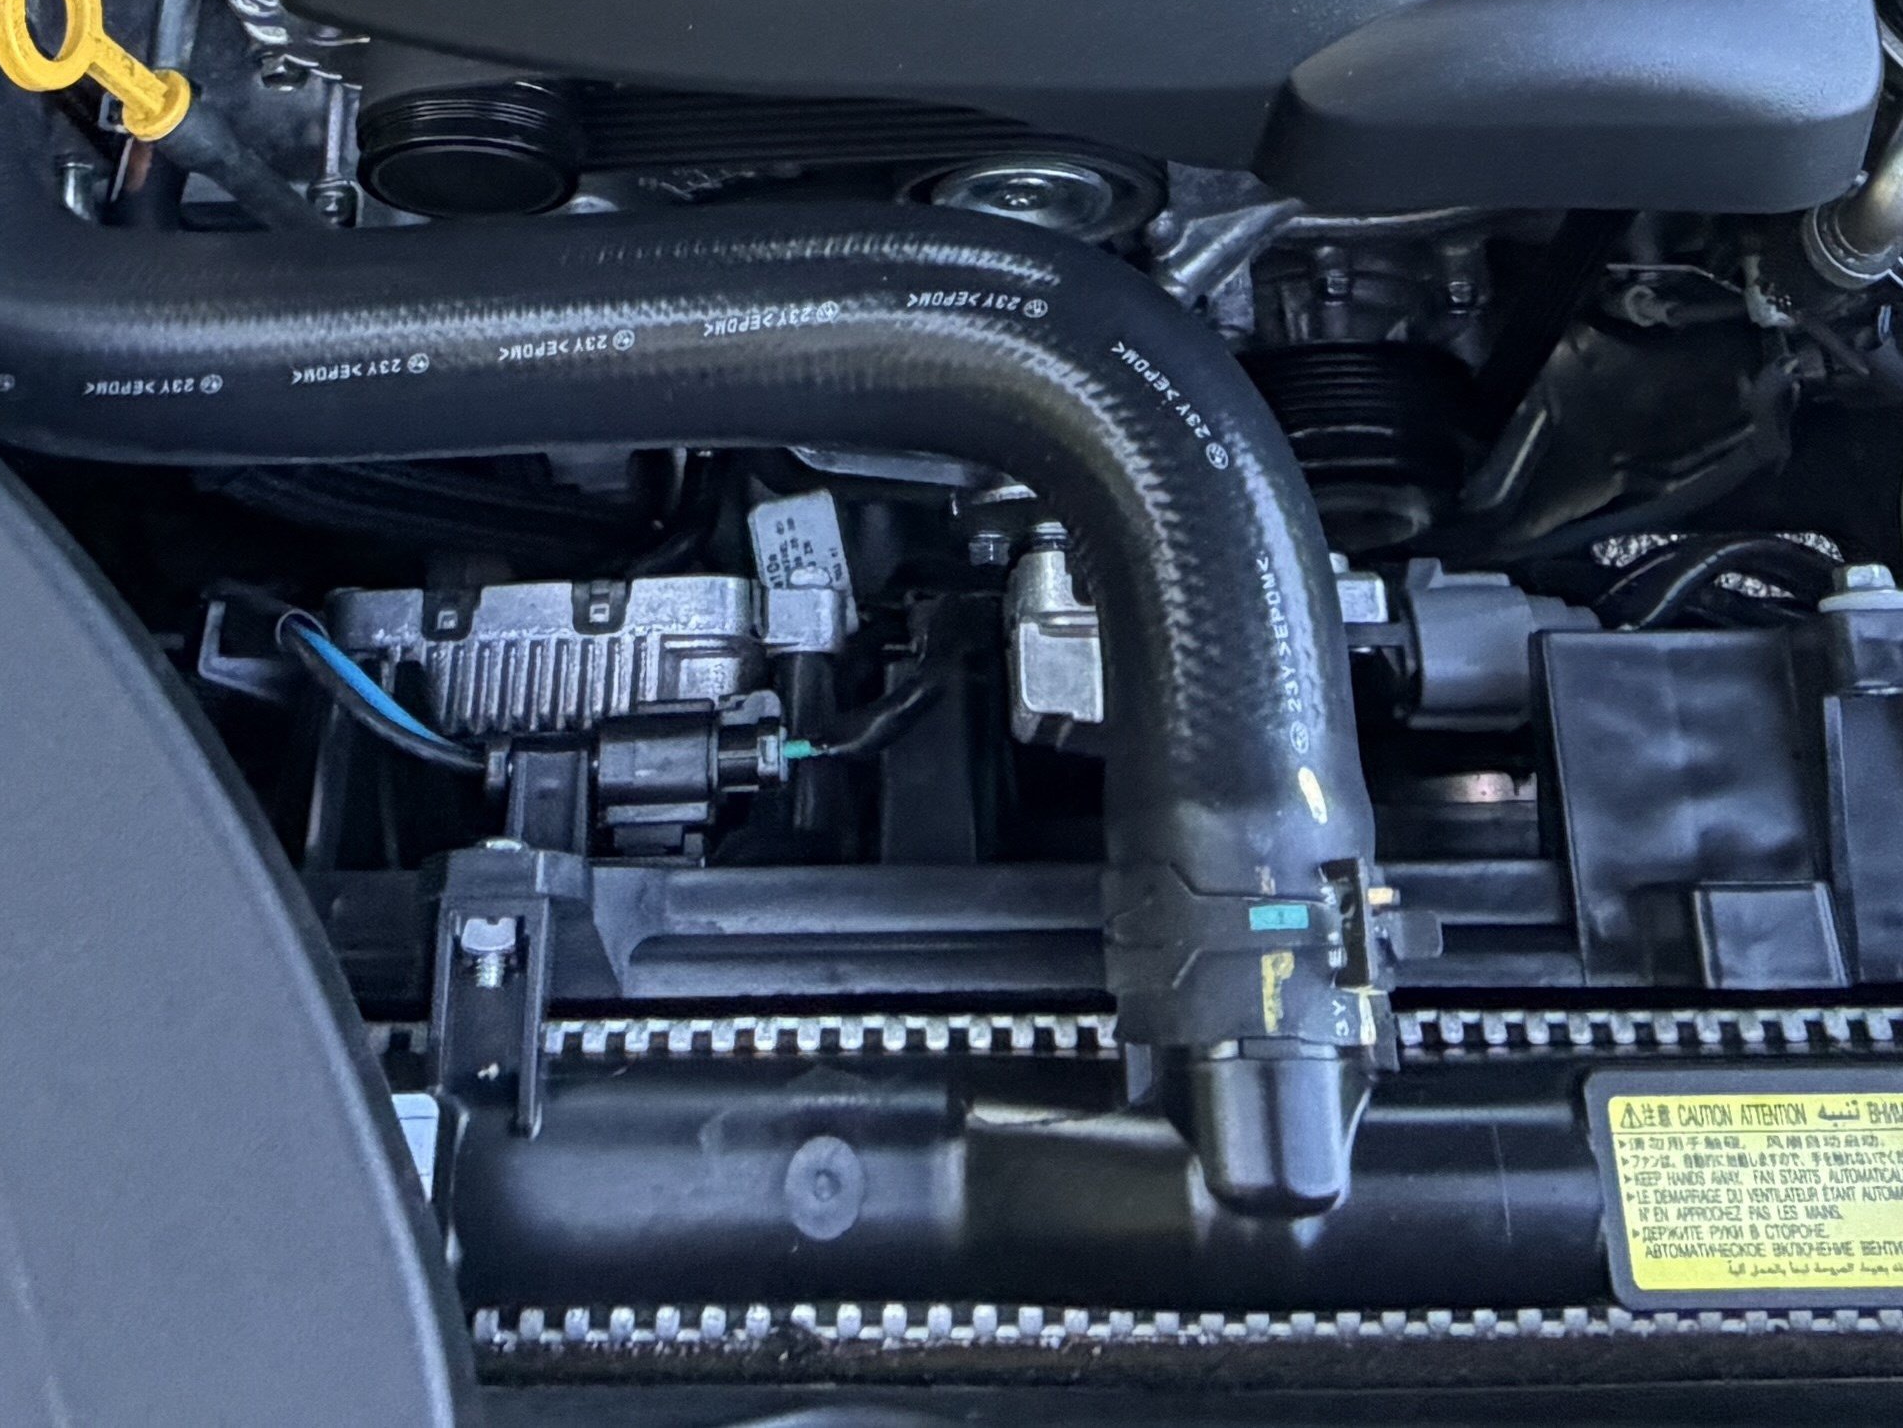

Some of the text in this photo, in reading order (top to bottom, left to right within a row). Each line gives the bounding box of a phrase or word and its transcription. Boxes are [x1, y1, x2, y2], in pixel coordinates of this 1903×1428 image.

[905, 289, 1022, 312] 23Y >EPDM<
[701, 306, 813, 337] 23Y >EPDM<
[496, 333, 609, 363] 23Y >EPDM<
[289, 356, 403, 384] 23Y >EPDM<
[83, 377, 195, 395] 23Y >EPDM<
[1111, 340, 1211, 447] 23Y >EPDM<
[1282, 659, 1304, 713] 23Y
[1676, 1102, 1733, 1127] CAUTION
[1737, 1102, 1808, 1126] ATTENTION
[1633, 1171, 1663, 1187] KEEP
[1666, 1171, 1706, 1186] HANDS
[1709, 1170, 1743, 1186] AWAY.
[1752, 1169, 1775, 1185] FAN
[1778, 1169, 1822, 1184] STARTS
[1635, 1190, 1652, 1206] LE
[1725, 1188, 1744, 1204] DU
[1746, 1187, 1820, 1203] VENTILATEUR
[1820, 1183, 1857, 1202] ÉTANT
[1674, 1206, 1743, 1222] APPROCHEZ
[1747, 1205, 1772, 1221] PAS
[1776, 1205, 1799, 1220] LES
[1803, 1204, 1843, 1220] MAINS.
[1640, 1225, 1704, 1242] ДЕРЖИТЕ
[1708, 1224, 1744, 1241] РУКИ
[1748, 1224, 1761, 1240] В
[1643, 1242, 1766, 1260] АВТОМАТИЧЕСКОЕ
[1771, 1240, 1855, 1258] ВКЛЮЧЕНИЕ
